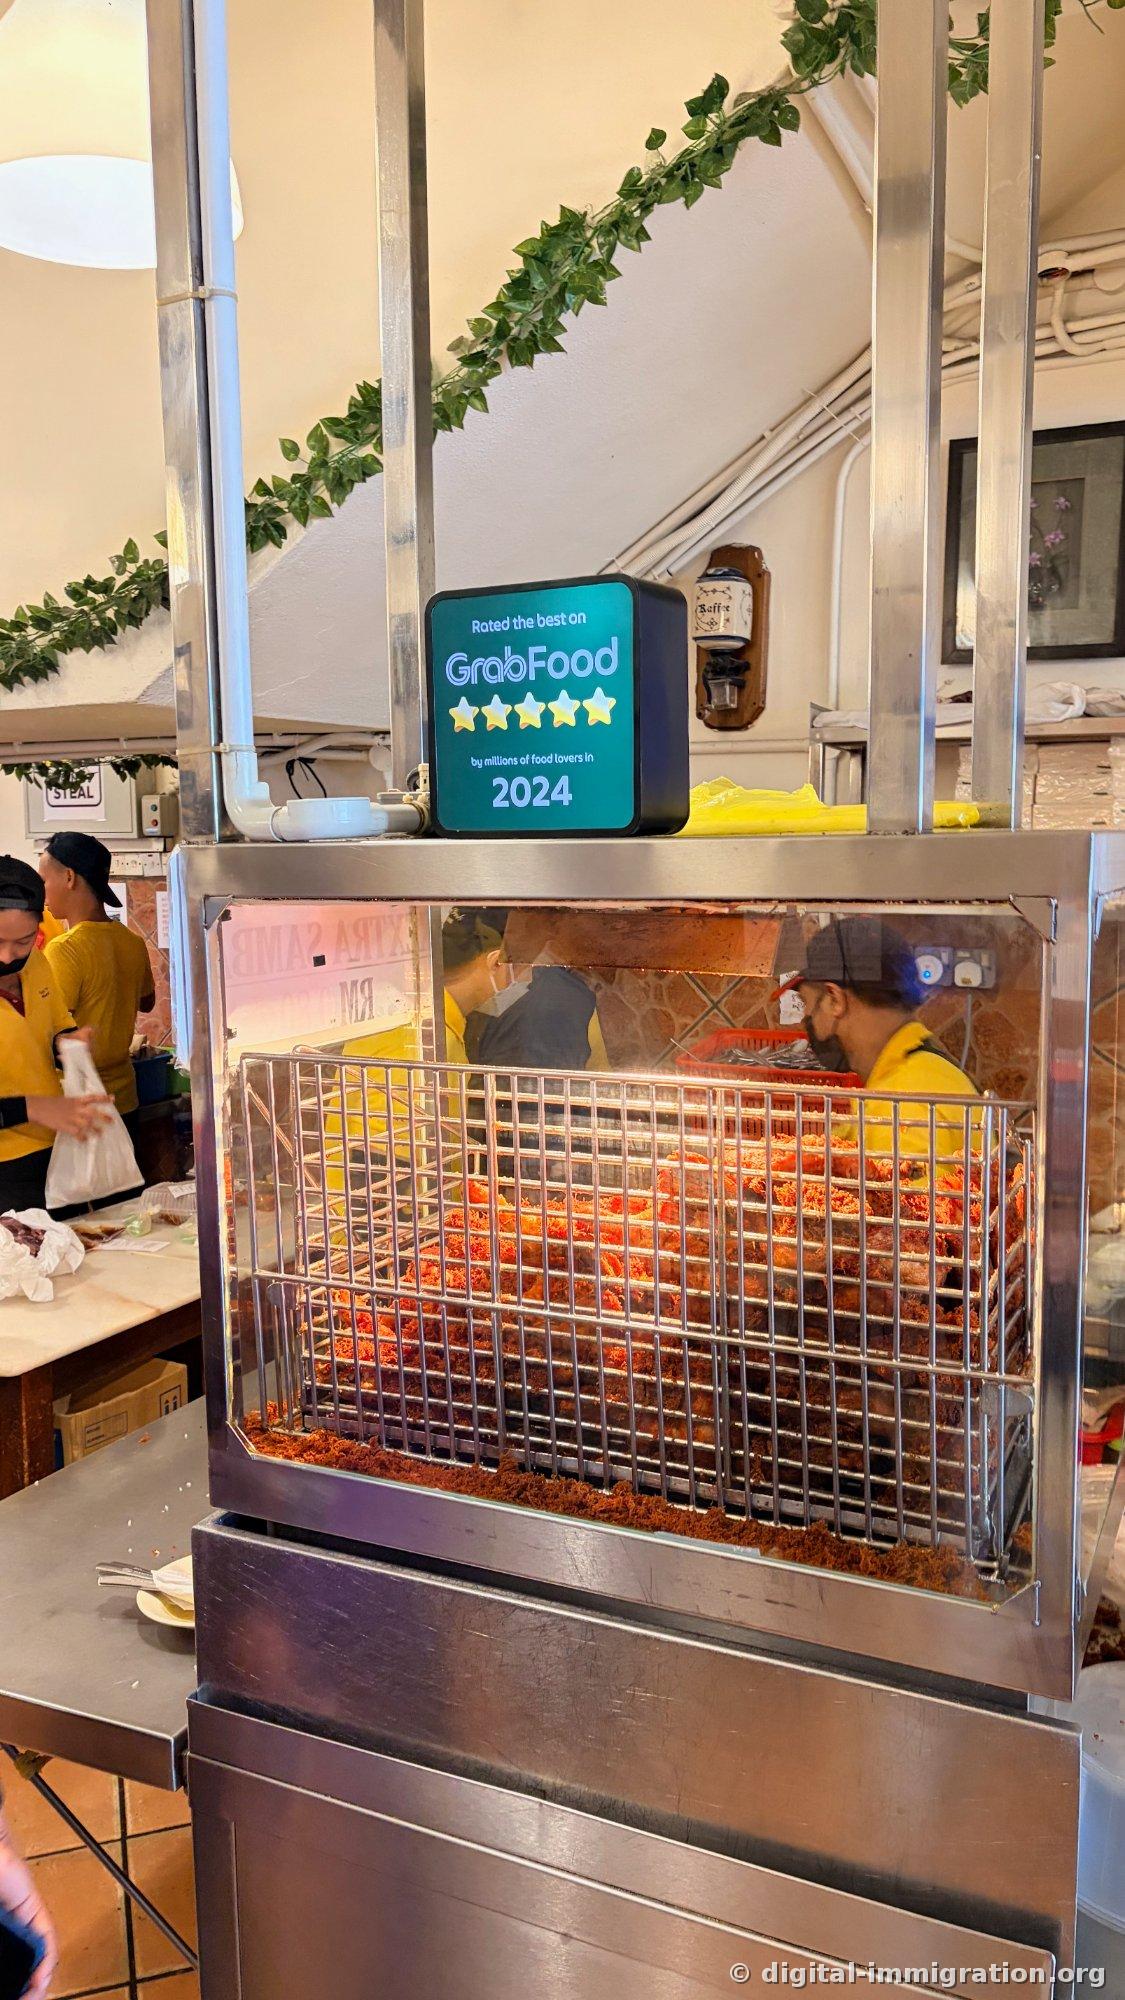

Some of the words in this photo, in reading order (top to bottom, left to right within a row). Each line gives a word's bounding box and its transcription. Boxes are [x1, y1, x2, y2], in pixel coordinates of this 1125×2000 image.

[472, 616, 510, 634] Rated
[513, 614, 534, 630] the
[536, 613, 567, 628] best
[569, 612, 587, 625] on
[446, 636, 619, 686] GrabFood
[470, 756, 483, 769] by
[484, 754, 518, 766] millions
[520, 754, 531, 765] of
[531, 754, 553, 765] food
[554, 753, 583, 764] lovers
[584, 752, 594, 763] in
[54, 786, 94, 799] STEAL
[492, 775, 573, 808] 2024
